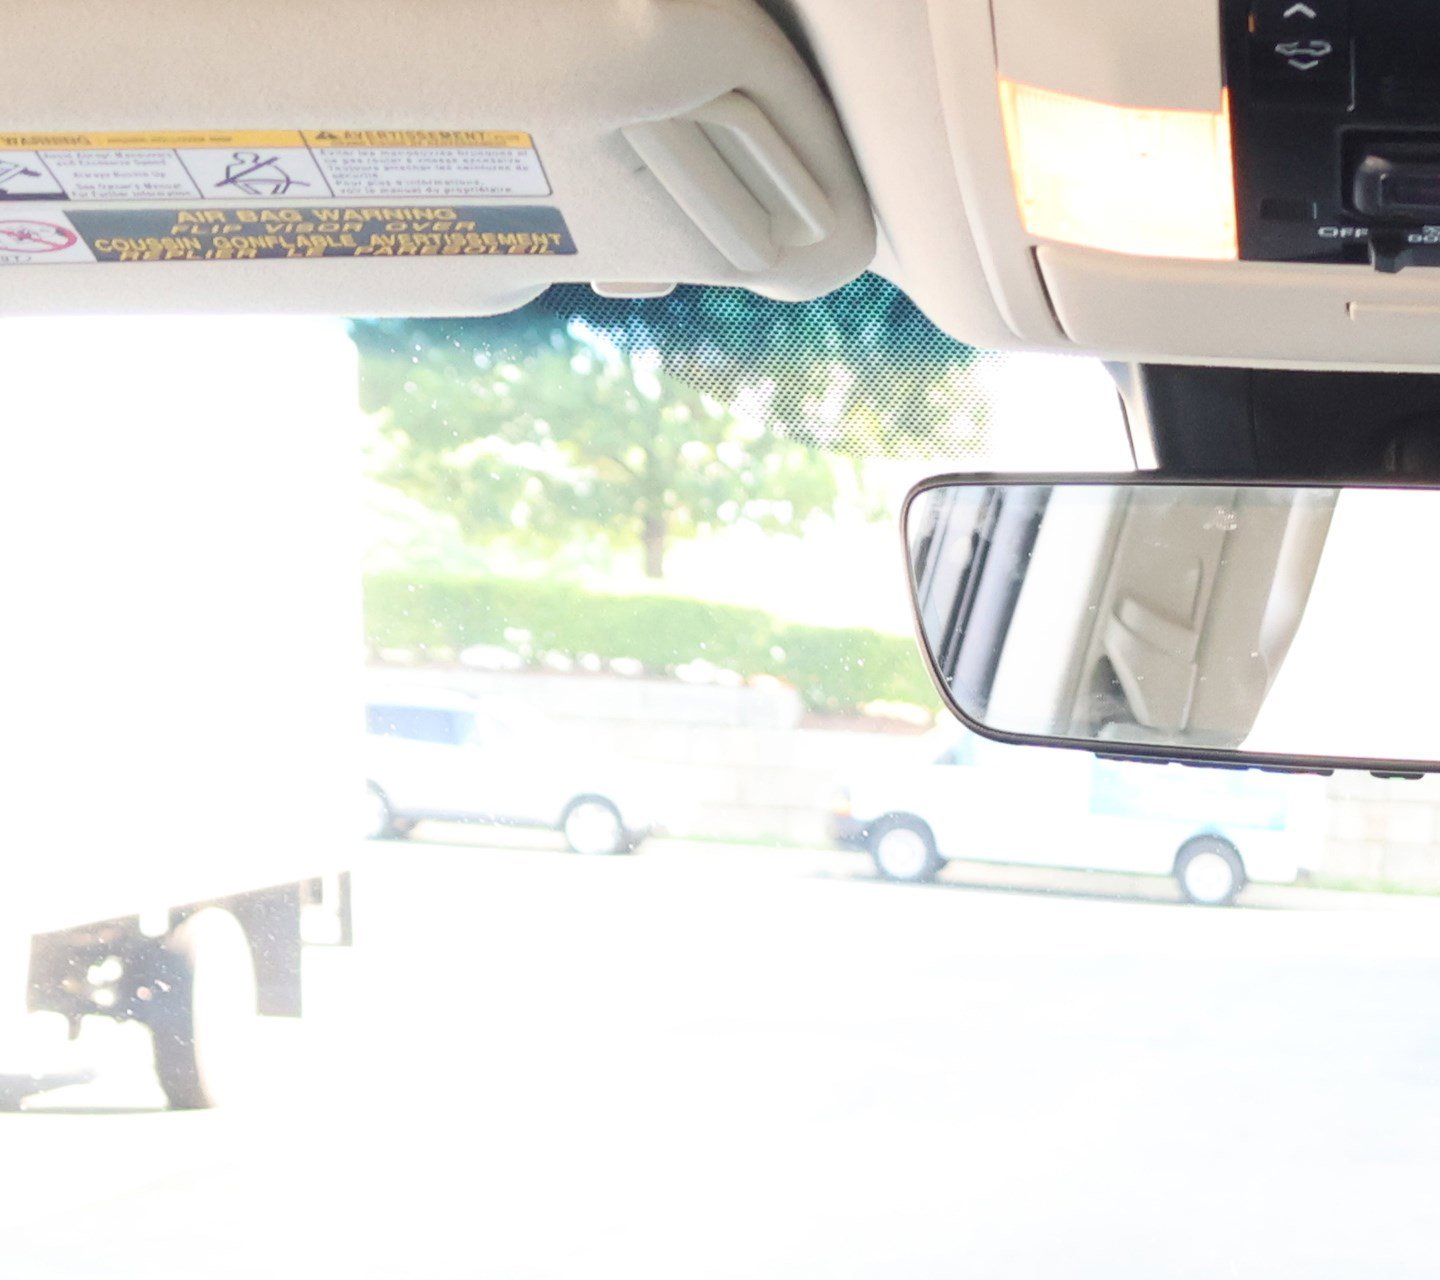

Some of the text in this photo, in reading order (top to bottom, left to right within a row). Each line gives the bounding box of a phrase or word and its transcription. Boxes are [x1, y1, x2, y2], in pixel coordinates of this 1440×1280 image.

[177, 206, 457, 224] AIR BAG WARNING
[170, 220, 474, 235] FLIP VISOR OVER
[1317, 225, 1369, 238] OFF
